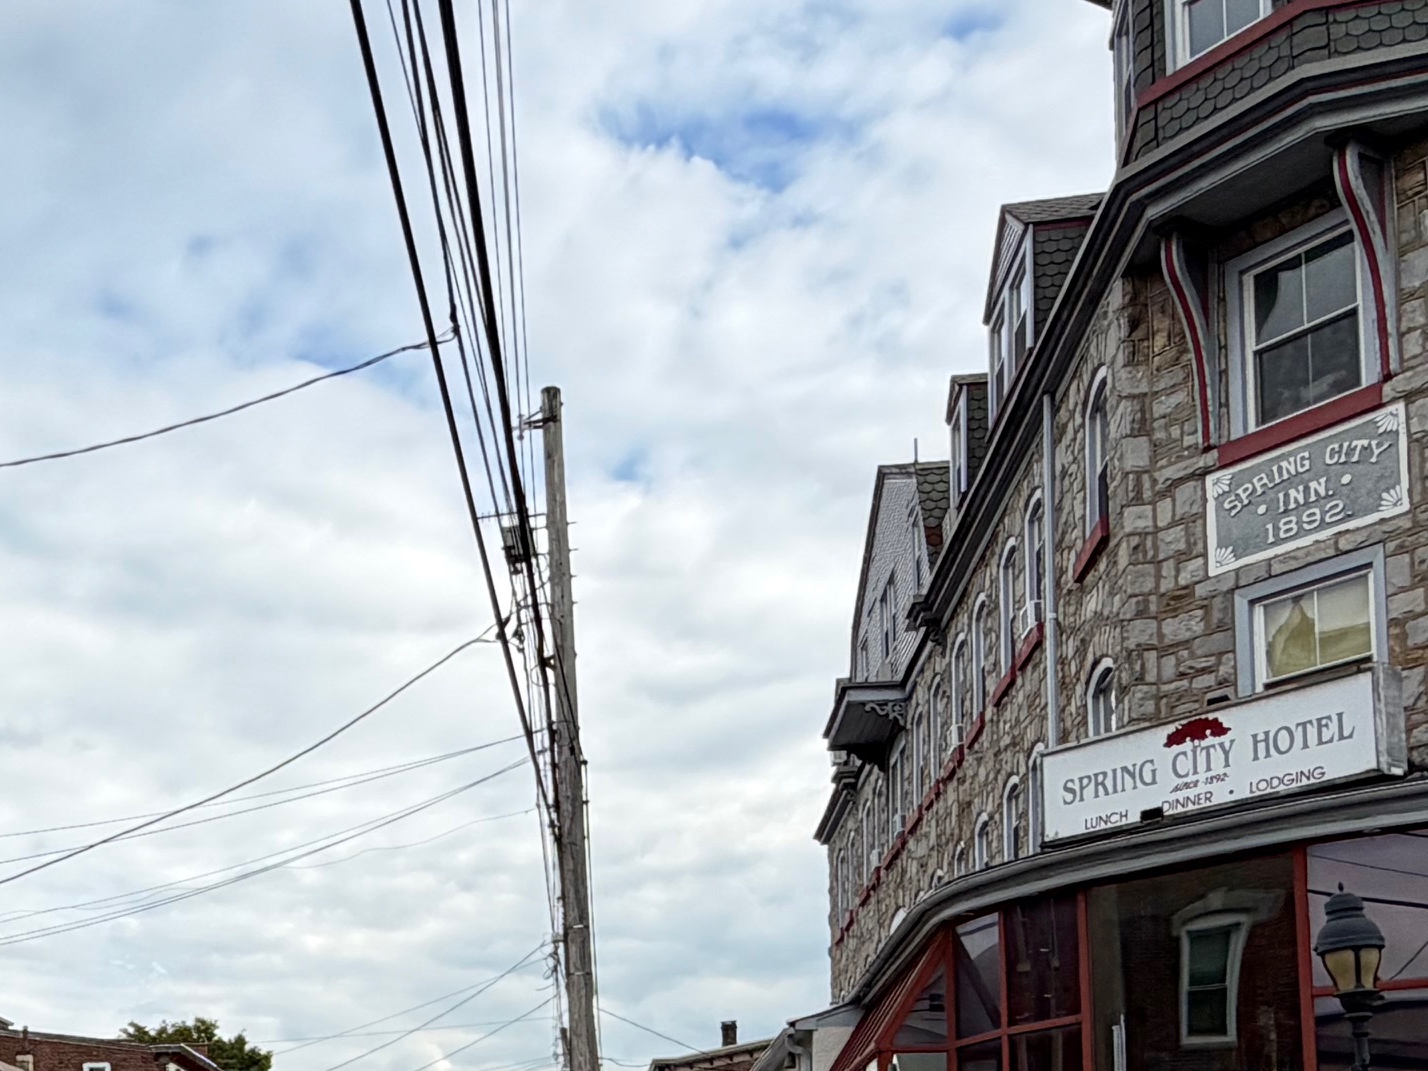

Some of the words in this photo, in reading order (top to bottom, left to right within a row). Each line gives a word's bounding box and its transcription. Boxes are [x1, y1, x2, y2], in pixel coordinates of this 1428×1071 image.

[1223, 451, 1311, 517] SPRING
[1325, 439, 1393, 466] CITY
[1062, 758, 1157, 806] SPRING
[1171, 738, 1236, 779] CITY
[1251, 711, 1356, 762] HOTEL
[1084, 809, 1129, 831] LUNCH
[1161, 791, 1214, 813] DINNER
[1249, 765, 1326, 795] LODGING
